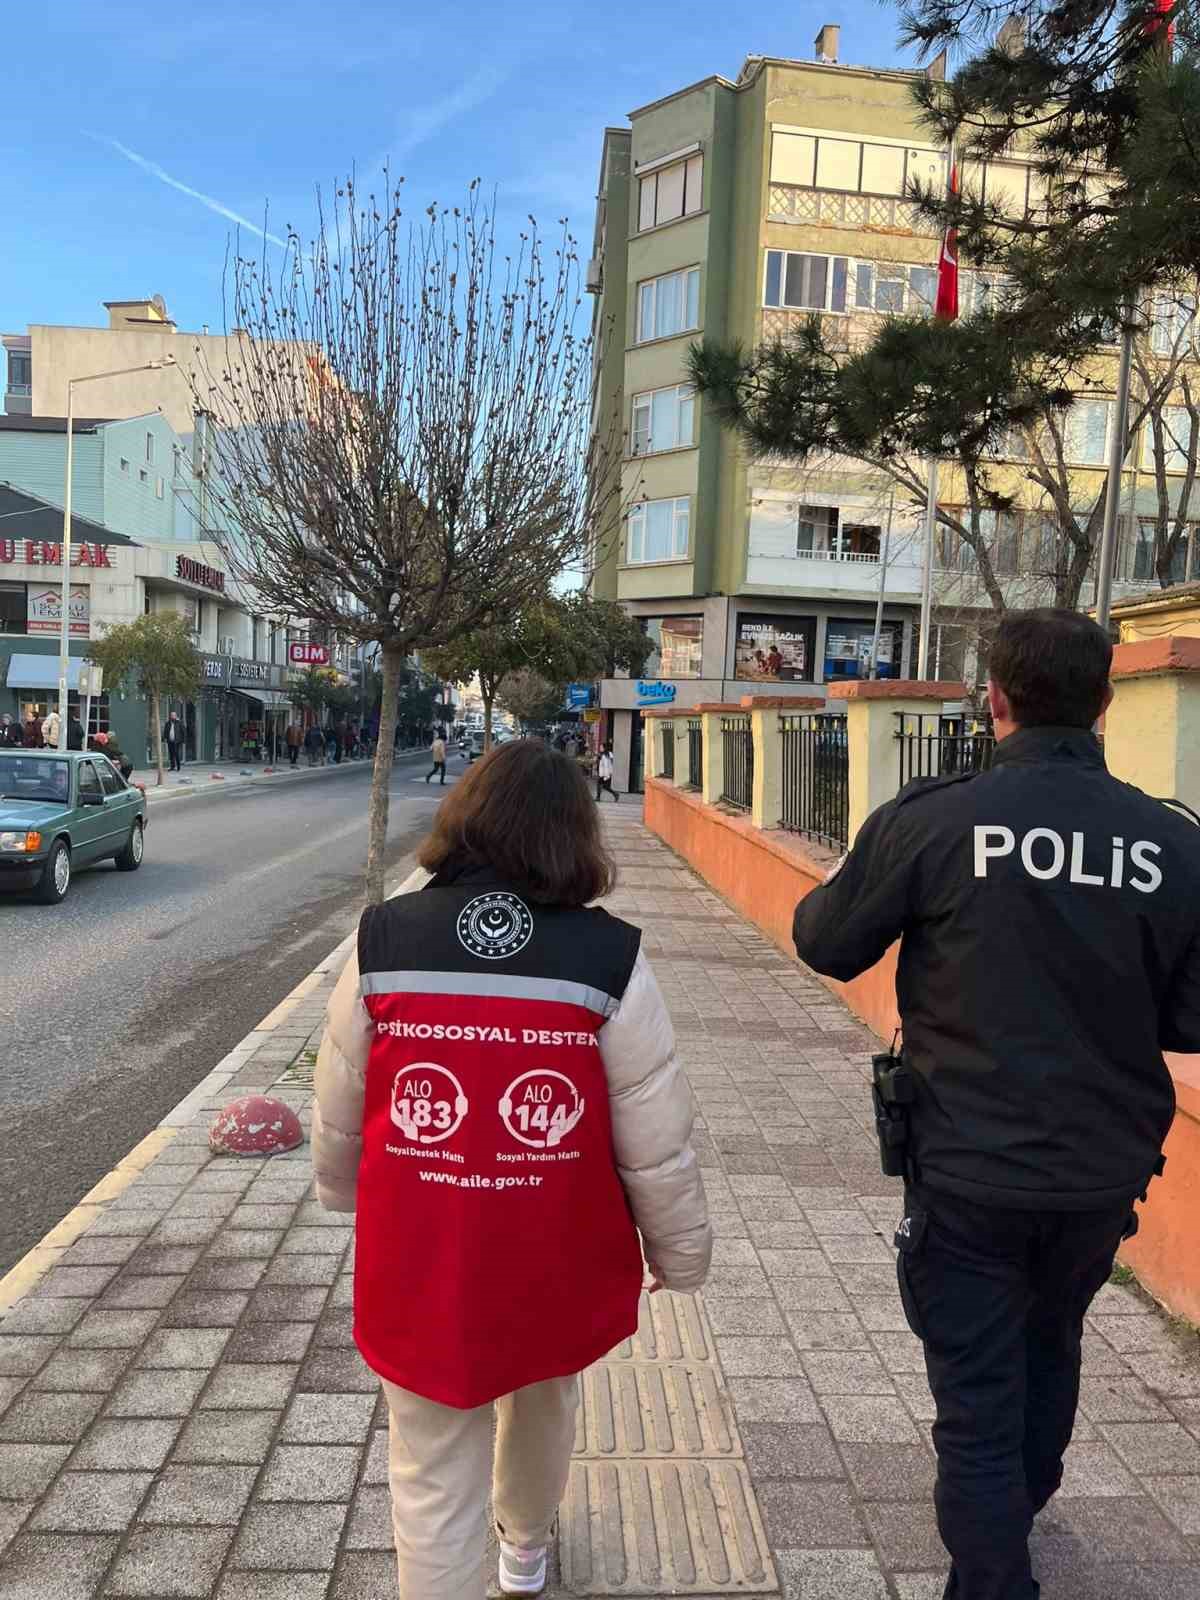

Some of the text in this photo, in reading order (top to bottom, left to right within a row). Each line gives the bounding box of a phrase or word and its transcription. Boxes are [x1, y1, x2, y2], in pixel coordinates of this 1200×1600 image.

[637, 681, 676, 697] beko
[377, 1020, 517, 1044] PSİKOSOSYAL
[404, 1080, 432, 1099] ALO
[524, 1085, 552, 1104] ALO
[397, 1099, 452, 1129] 183
[515, 1104, 568, 1133] 144
[410, 1147, 440, 1159] Destek
[496, 1152, 525, 1163] Sosyal
[526, 1152, 556, 1161] Yardım
[419, 1171, 543, 1190] www.aile.gov.tr
